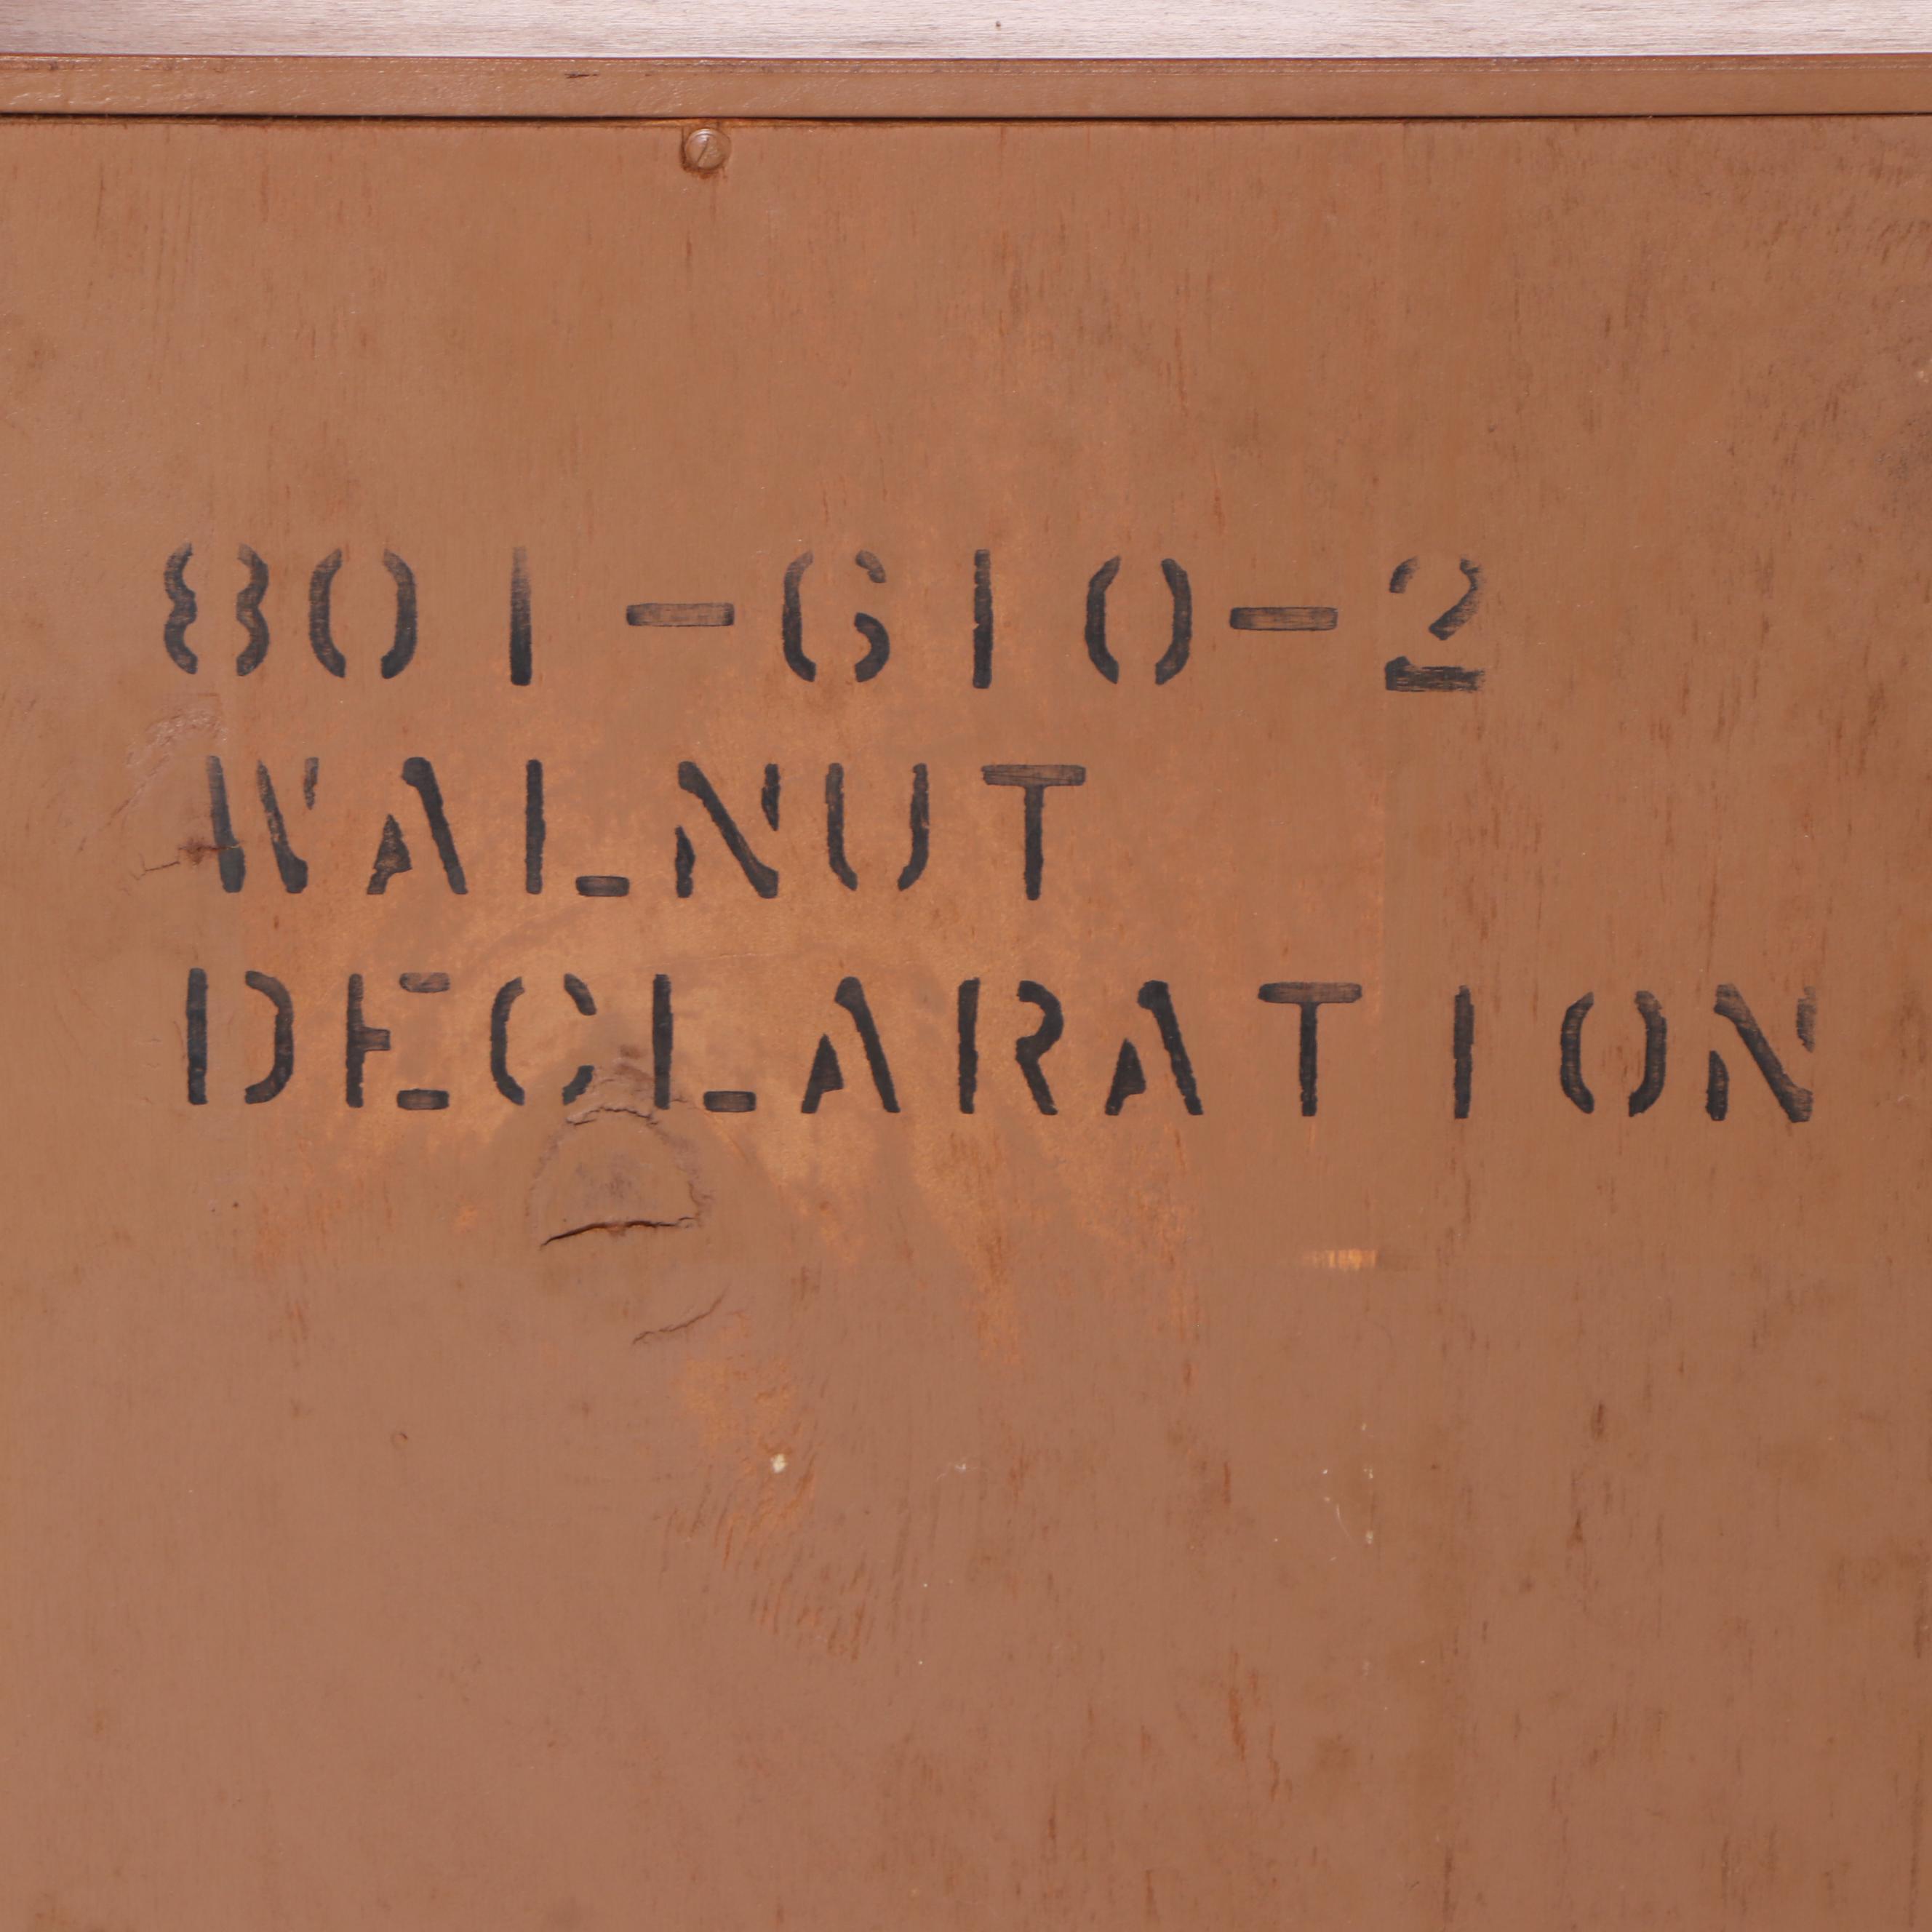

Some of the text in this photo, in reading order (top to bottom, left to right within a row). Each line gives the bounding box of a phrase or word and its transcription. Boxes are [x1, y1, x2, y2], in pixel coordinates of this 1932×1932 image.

[164, 543, 1485, 692] 801-610-2
[207, 757, 1085, 901] WALNUT
[186, 968, 1815, 1123] DECLARATION
